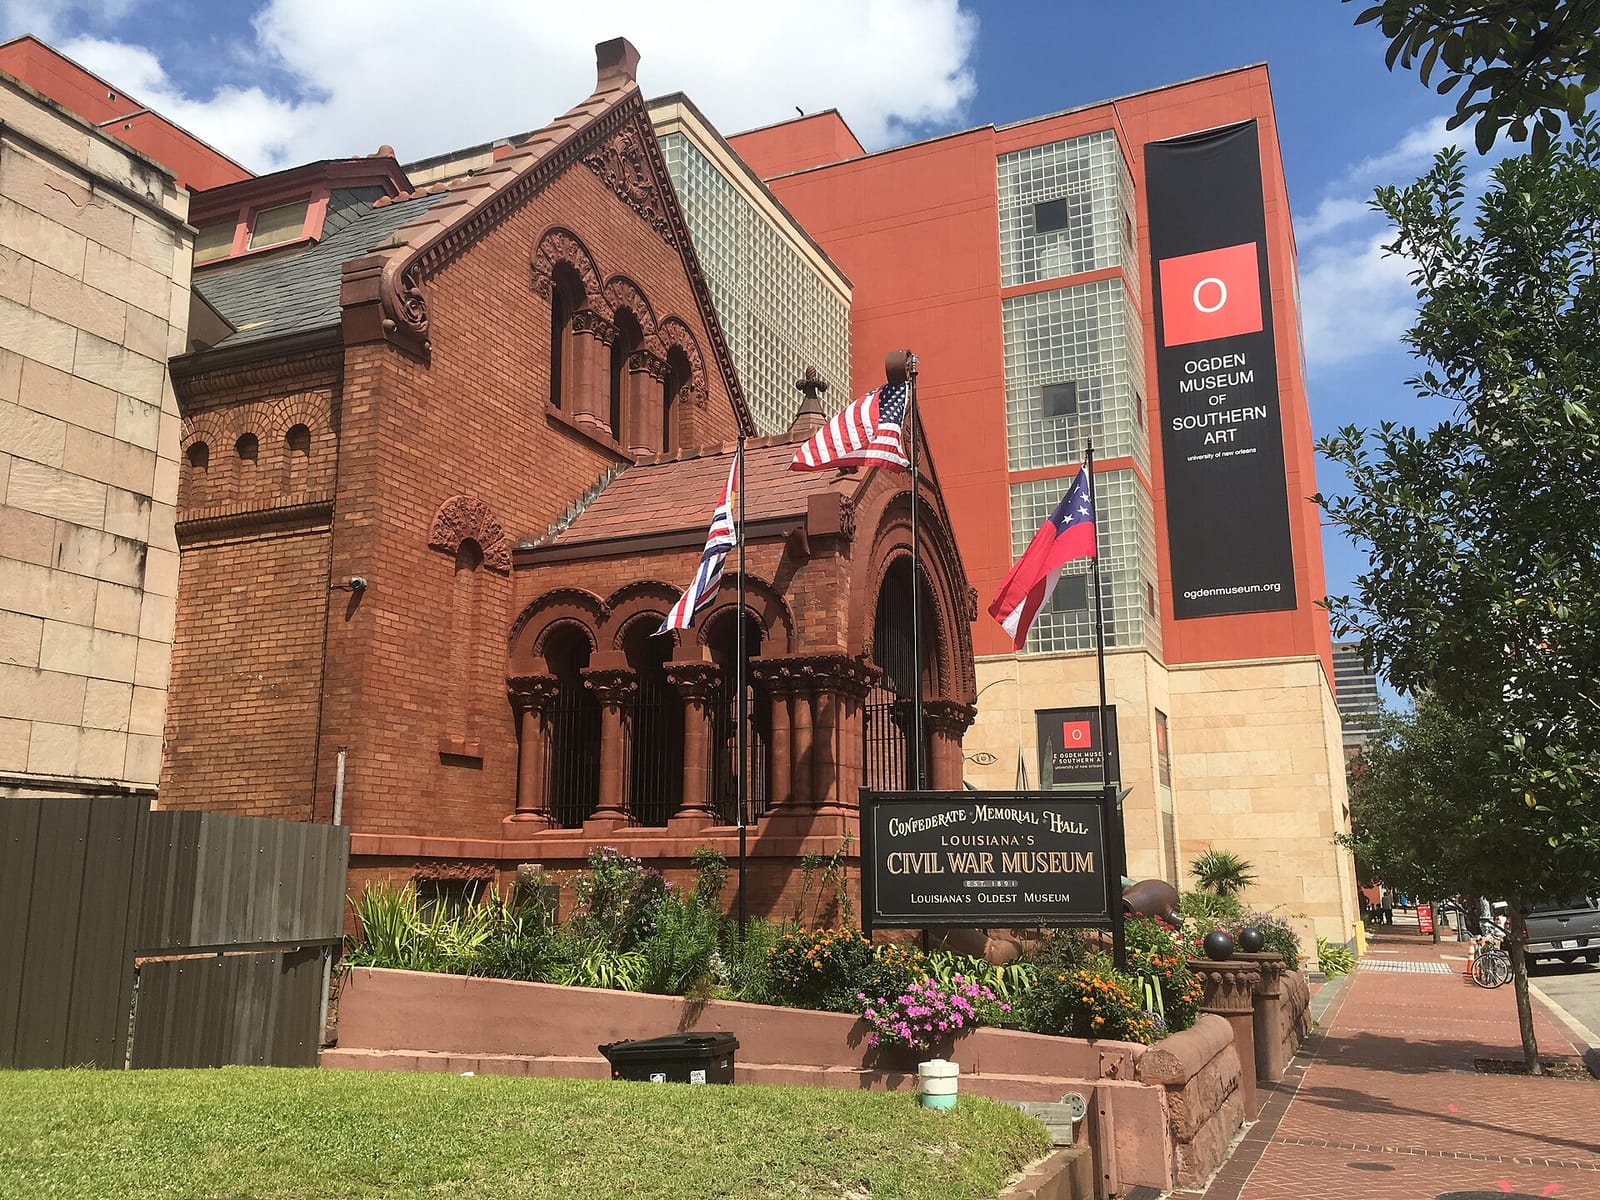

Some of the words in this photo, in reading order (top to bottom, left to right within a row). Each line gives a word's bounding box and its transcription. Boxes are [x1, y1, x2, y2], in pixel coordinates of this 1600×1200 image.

[1193, 277, 1227, 313] O
[1184, 352, 1246, 375] OGDEN
[1179, 369, 1254, 393] MUSEUM
[1208, 393, 1227, 407] OF
[1172, 405, 1268, 431] SOUTHERN
[1203, 427, 1238, 446] ART
[1187, 453, 1214, 462] university
[1234, 447, 1257, 456] orleans
[1183, 582, 1281, 599] ogdenmuseum.org
[1072, 729, 1082, 740] O
[888, 809, 967, 837] CONFEDERATE
[971, 804, 1039, 825] MEMORIAL
[1042, 810, 1089, 835] HALL
[940, 835, 1035, 846] LOUISIANA'S
[886, 851, 945, 875] CIVIL
[948, 851, 995, 874] WAR
[1001, 851, 1095, 874] MUSEUM
[911, 893, 971, 904] LOUISIANA'S
[977, 892, 1018, 903] OLDEST
[1024, 892, 1070, 903] MUSEUM
